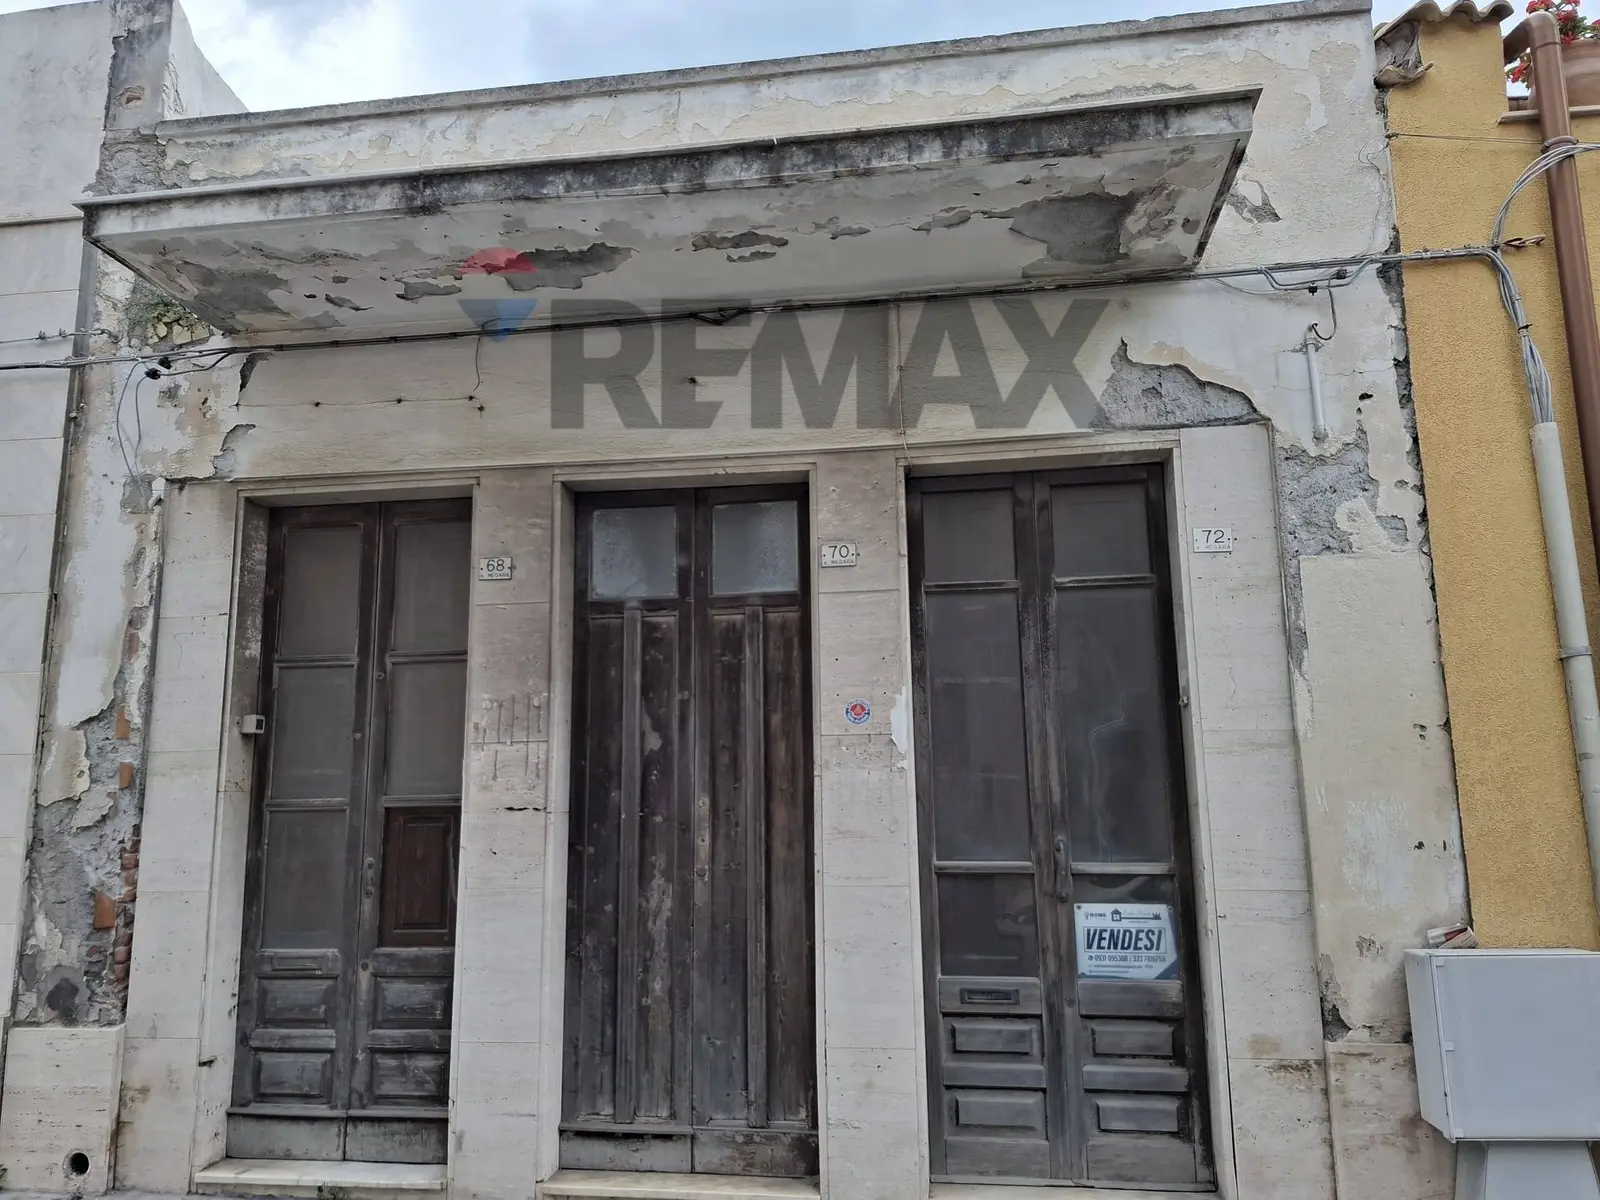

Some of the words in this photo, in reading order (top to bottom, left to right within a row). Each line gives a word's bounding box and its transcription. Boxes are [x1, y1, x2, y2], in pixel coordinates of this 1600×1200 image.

[1202, 529, 1225, 544] 72
[828, 545, 850, 559] 70
[487, 559, 505, 572] 68
[1086, 928, 1163, 952] VENDESI
